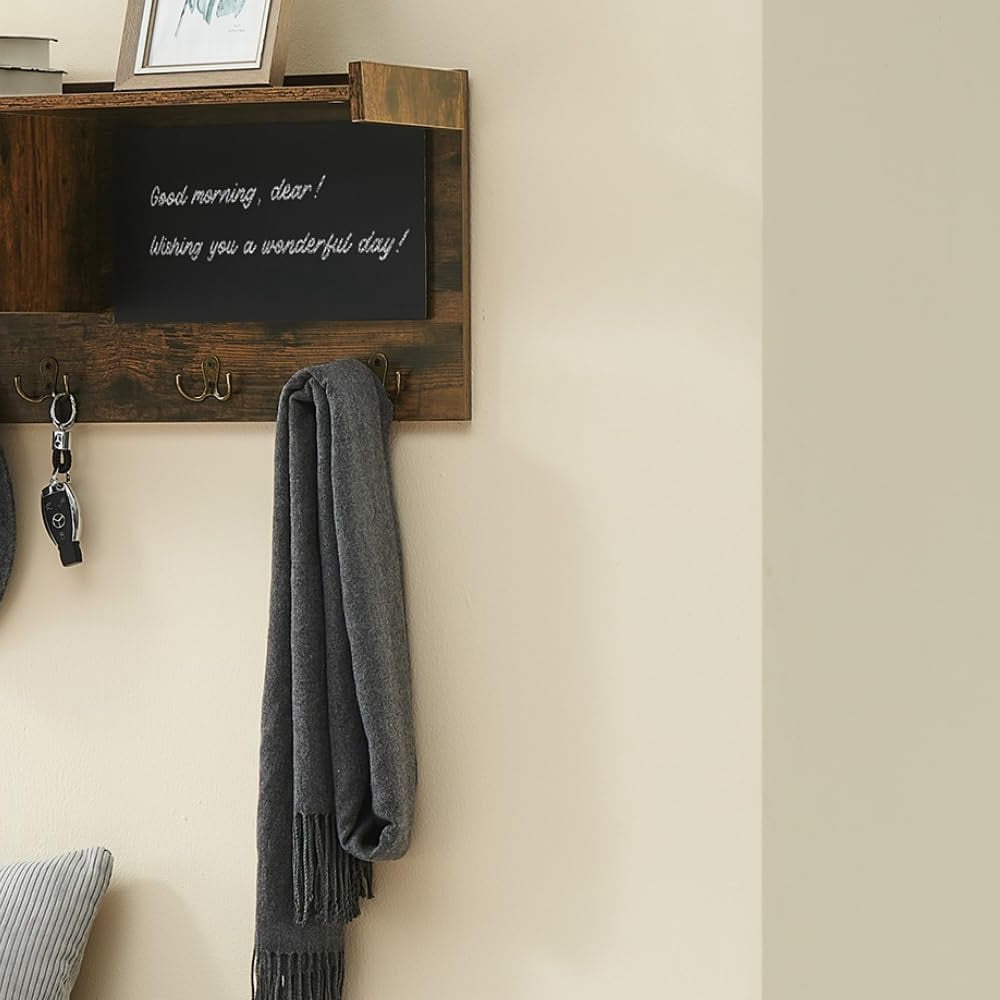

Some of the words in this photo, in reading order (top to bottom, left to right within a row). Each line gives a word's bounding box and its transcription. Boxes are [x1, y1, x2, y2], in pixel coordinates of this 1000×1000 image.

[150, 185, 188, 207] Good
[191, 183, 262, 209] morning,
[271, 174, 326, 201] dear!
[150, 235, 203, 261] Wishing
[209, 242, 239, 262] you
[243, 241, 257, 254] a
[261, 232, 353, 261] wonderful
[358, 228, 410, 261] day!
